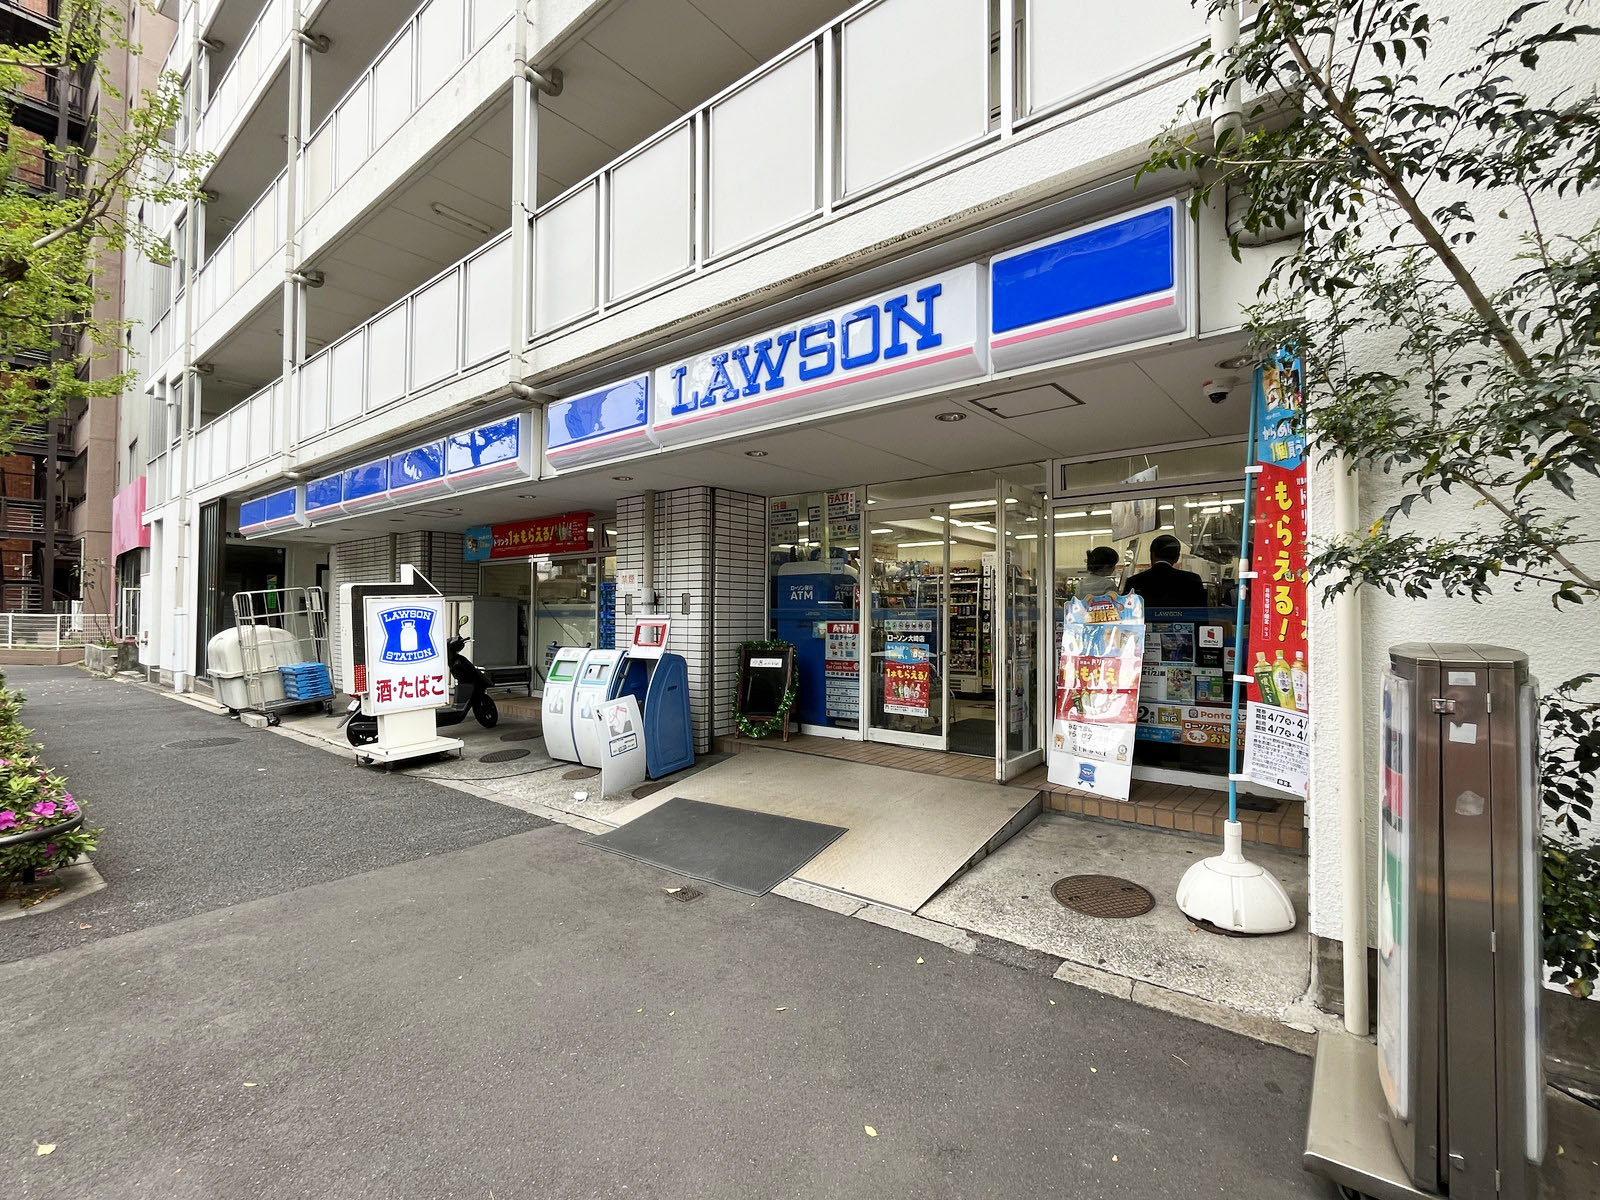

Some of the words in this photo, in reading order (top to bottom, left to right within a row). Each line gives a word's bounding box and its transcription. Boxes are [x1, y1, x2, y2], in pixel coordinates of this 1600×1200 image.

[671, 283, 942, 416] LAWSON
[790, 591, 813, 600] ATM
[383, 609, 432, 623] LAWSON
[832, 624, 854, 633] ATM
[385, 647, 433, 661] STATION
[376, 675, 444, 703] 酒・たばこ
